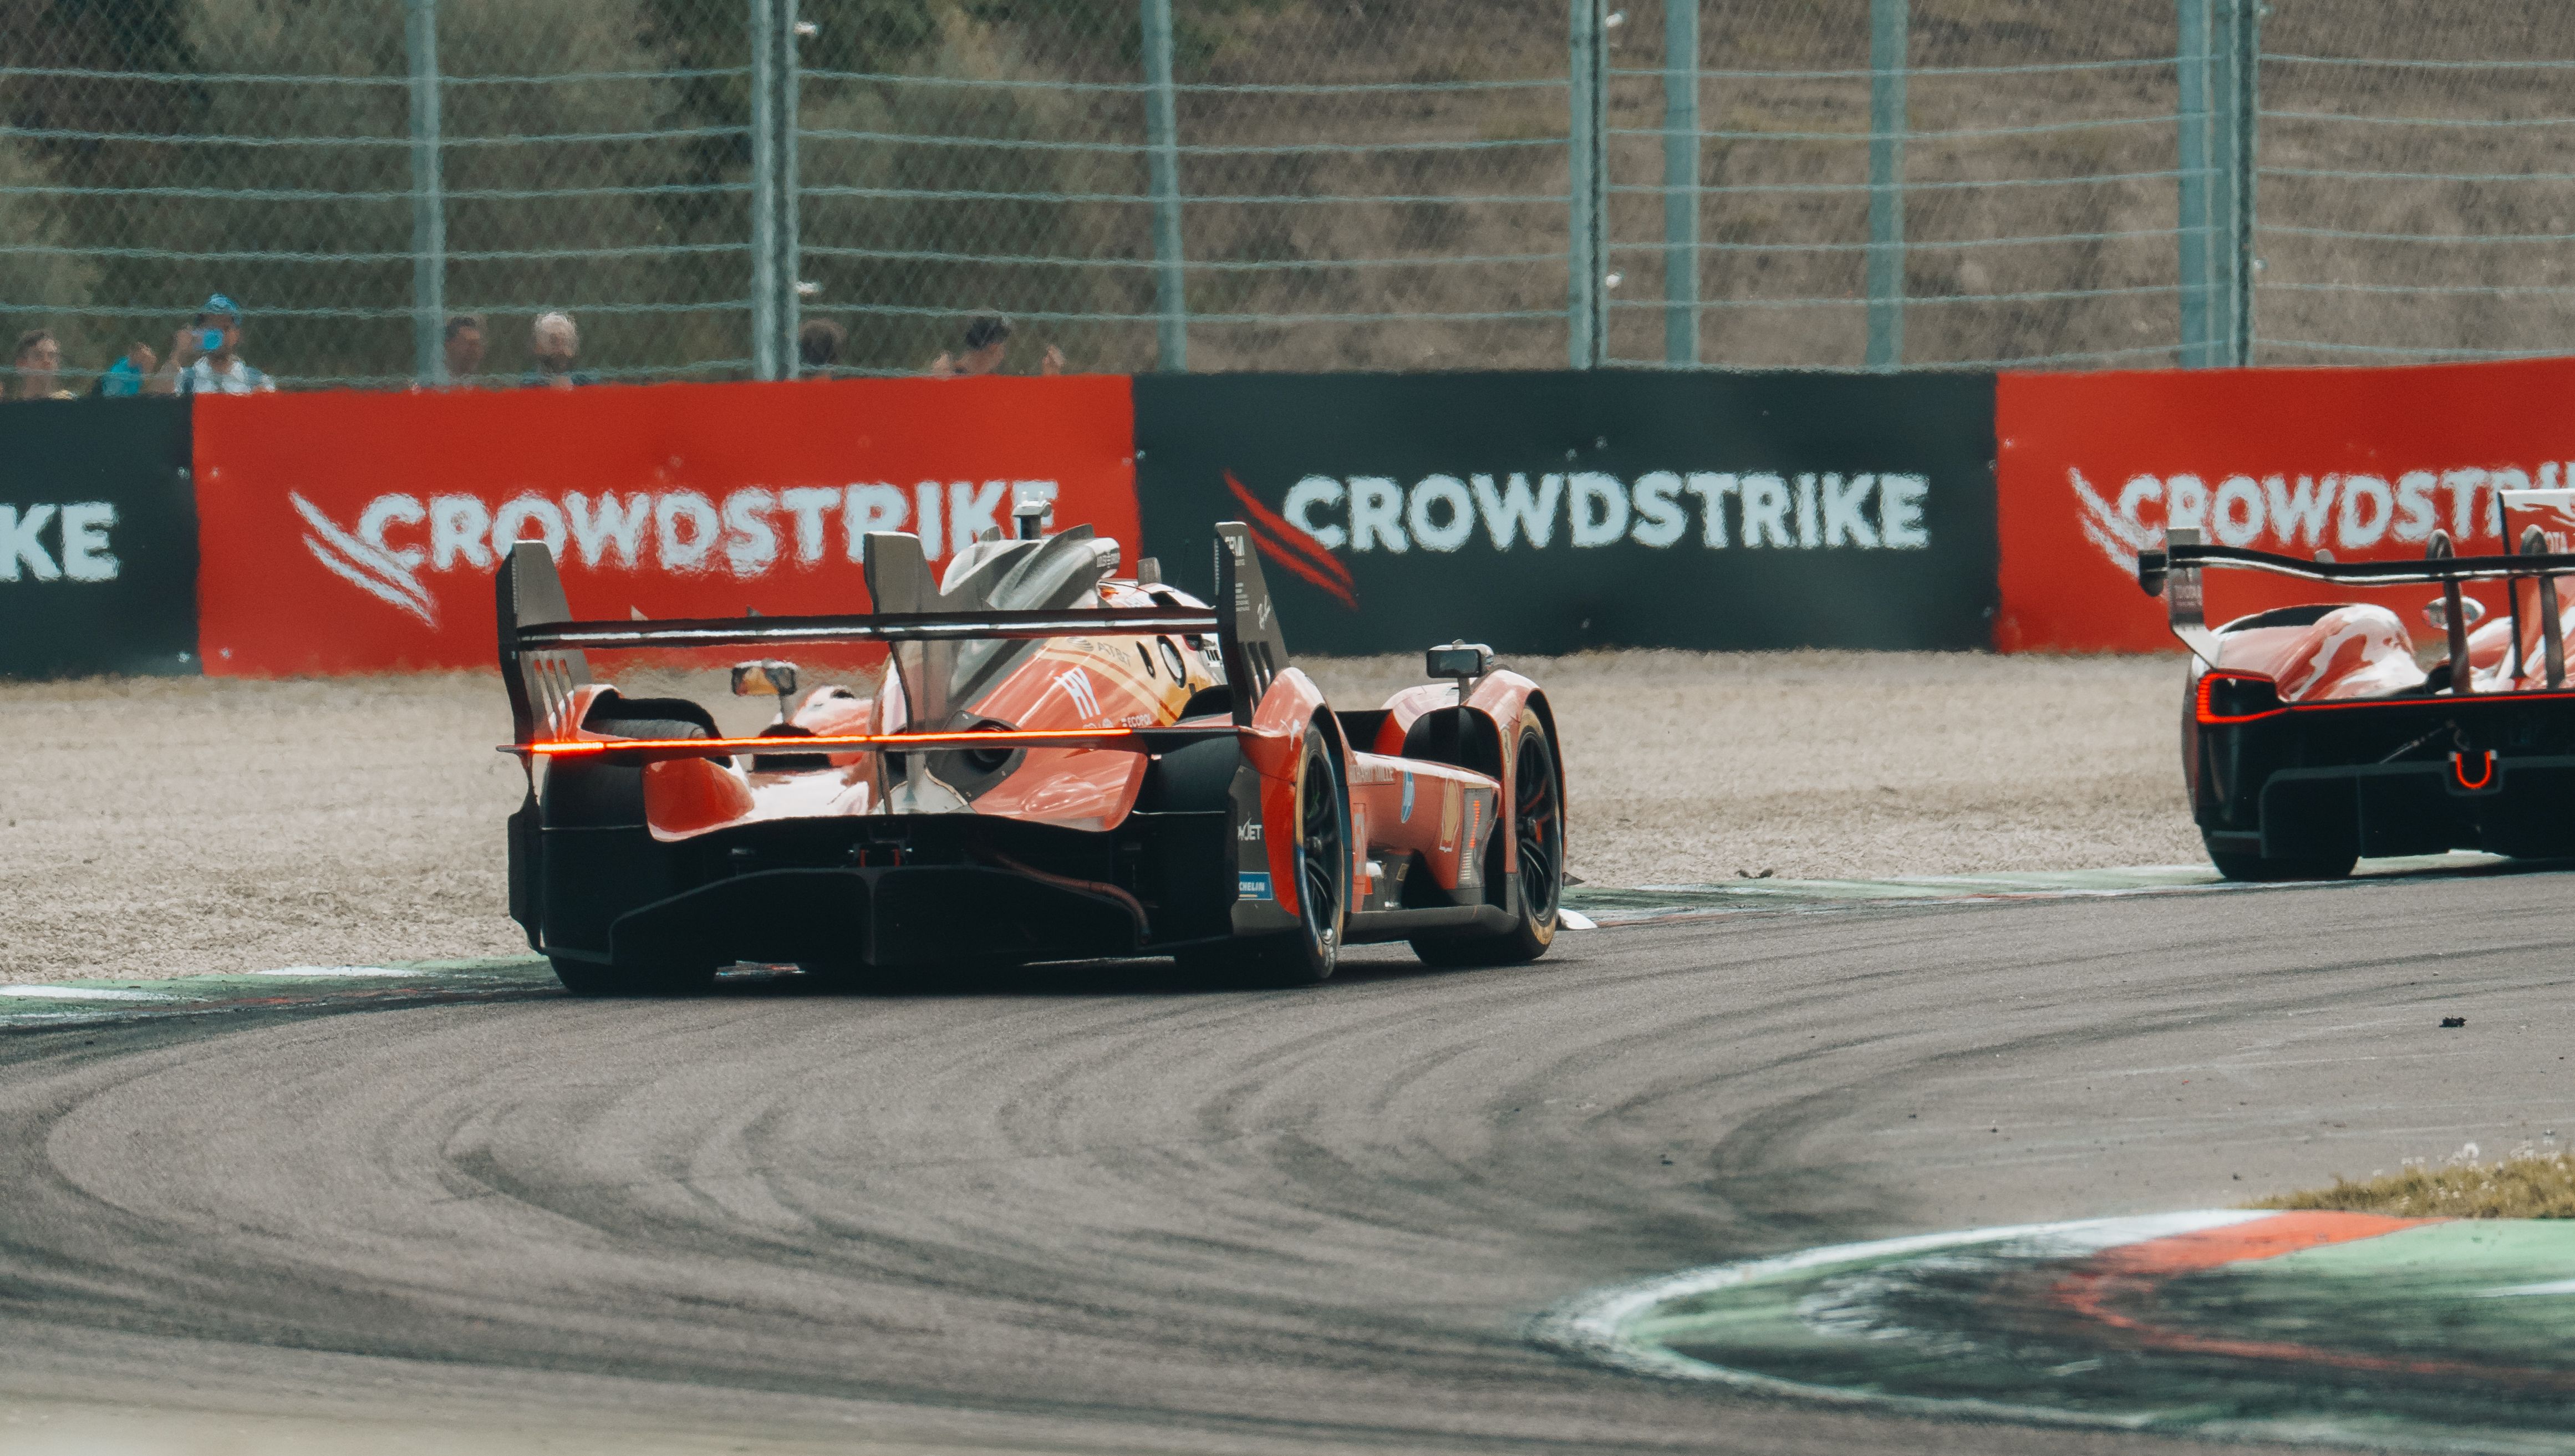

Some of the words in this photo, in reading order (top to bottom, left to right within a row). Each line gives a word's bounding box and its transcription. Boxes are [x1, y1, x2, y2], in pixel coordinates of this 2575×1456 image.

[1283, 471, 1931, 553] CROWDSTRIKE
[2118, 461, 2575, 548] CROWDST
[1097, 642, 1131, 667] AT&T
[1239, 881, 1265, 892] CHELIN
